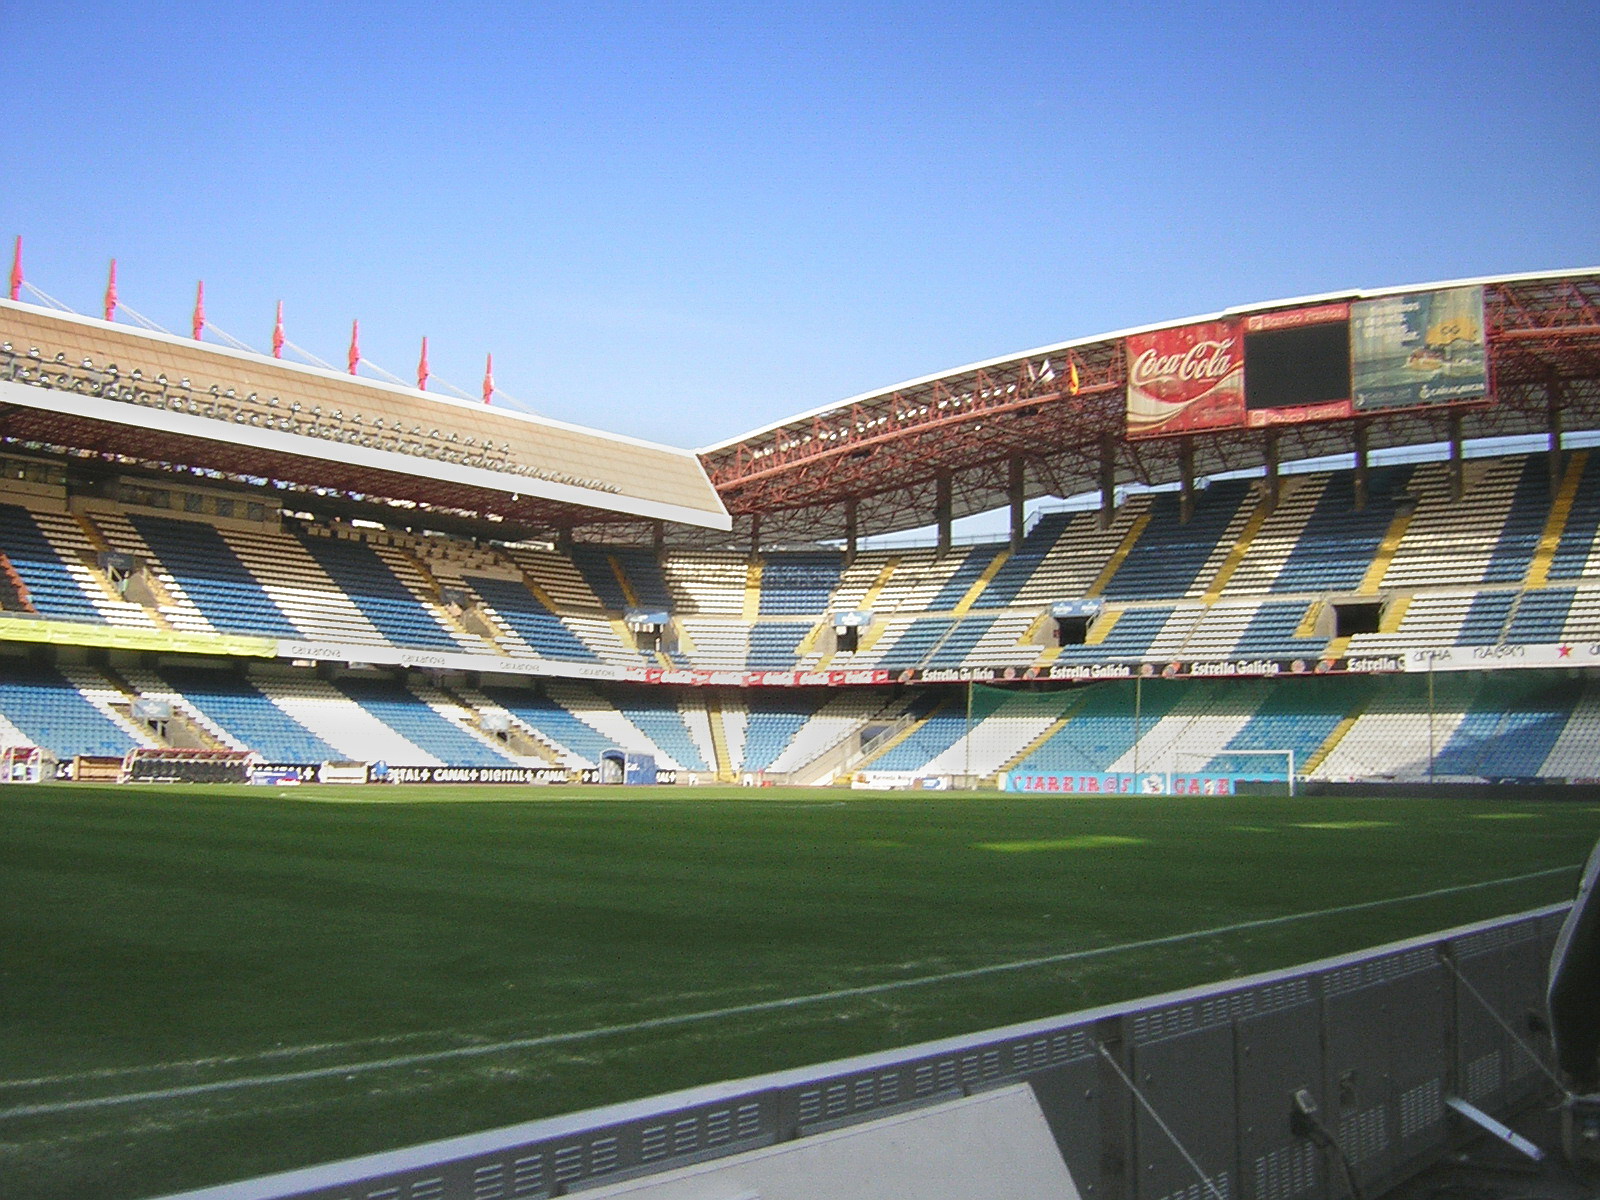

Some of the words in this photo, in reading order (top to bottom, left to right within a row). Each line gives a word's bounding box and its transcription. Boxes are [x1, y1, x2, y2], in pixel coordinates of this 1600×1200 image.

[1131, 337, 1236, 386] Coca-Cola
[1050, 665, 1090, 679] Estrella
[1091, 663, 1130, 677] Galicia
[1191, 660, 1235, 675] Estrella
[1236, 659, 1279, 674] Galicia
[1347, 657, 1397, 672] Estrella
[921, 668, 959, 681] Estrella
